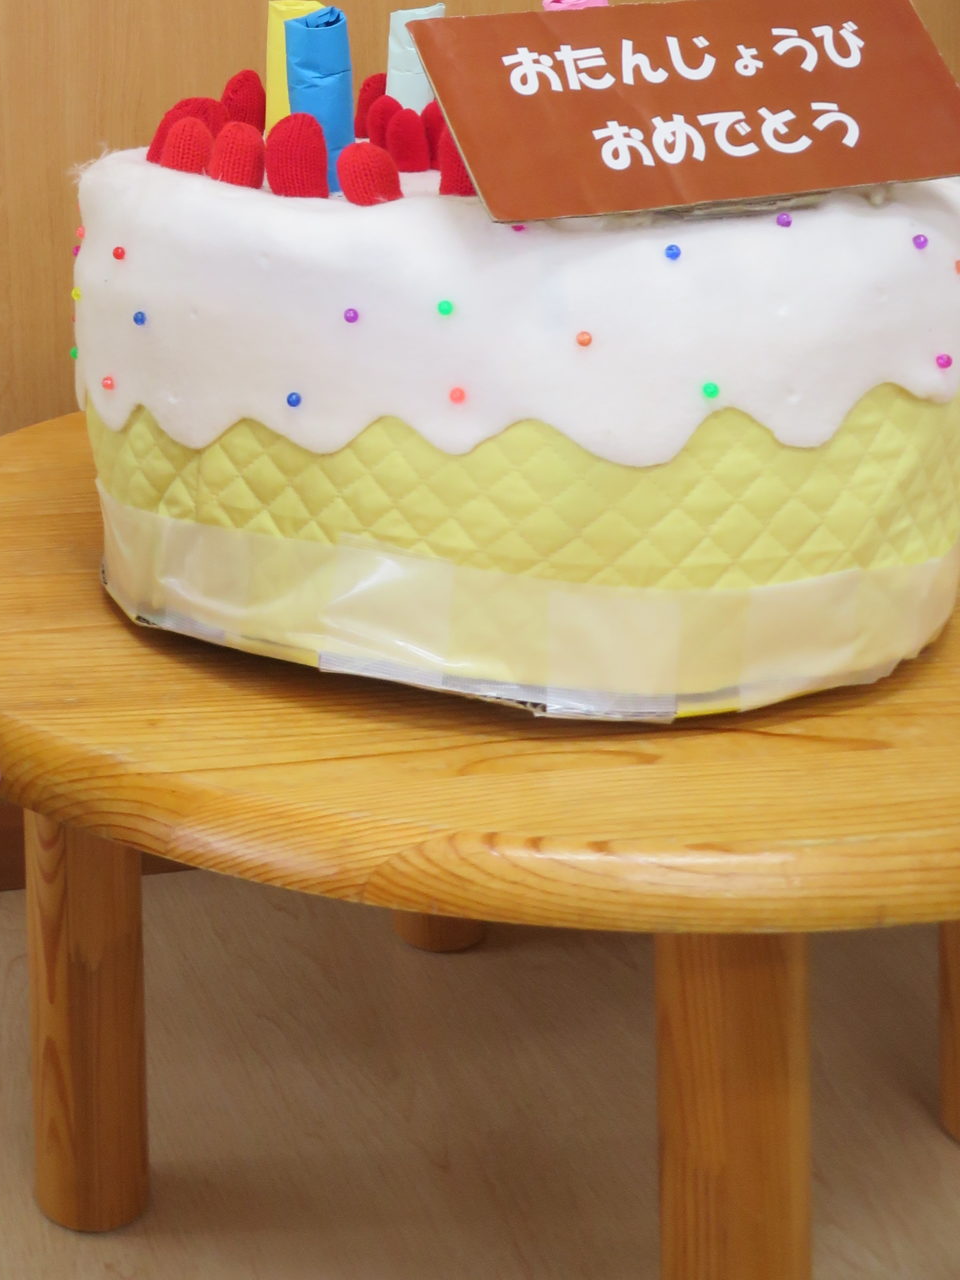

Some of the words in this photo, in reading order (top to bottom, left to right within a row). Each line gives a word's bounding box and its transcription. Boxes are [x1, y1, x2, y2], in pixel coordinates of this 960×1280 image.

[501, 21, 865, 96] おたんじょうび
[592, 102, 860, 171] おめでとう
